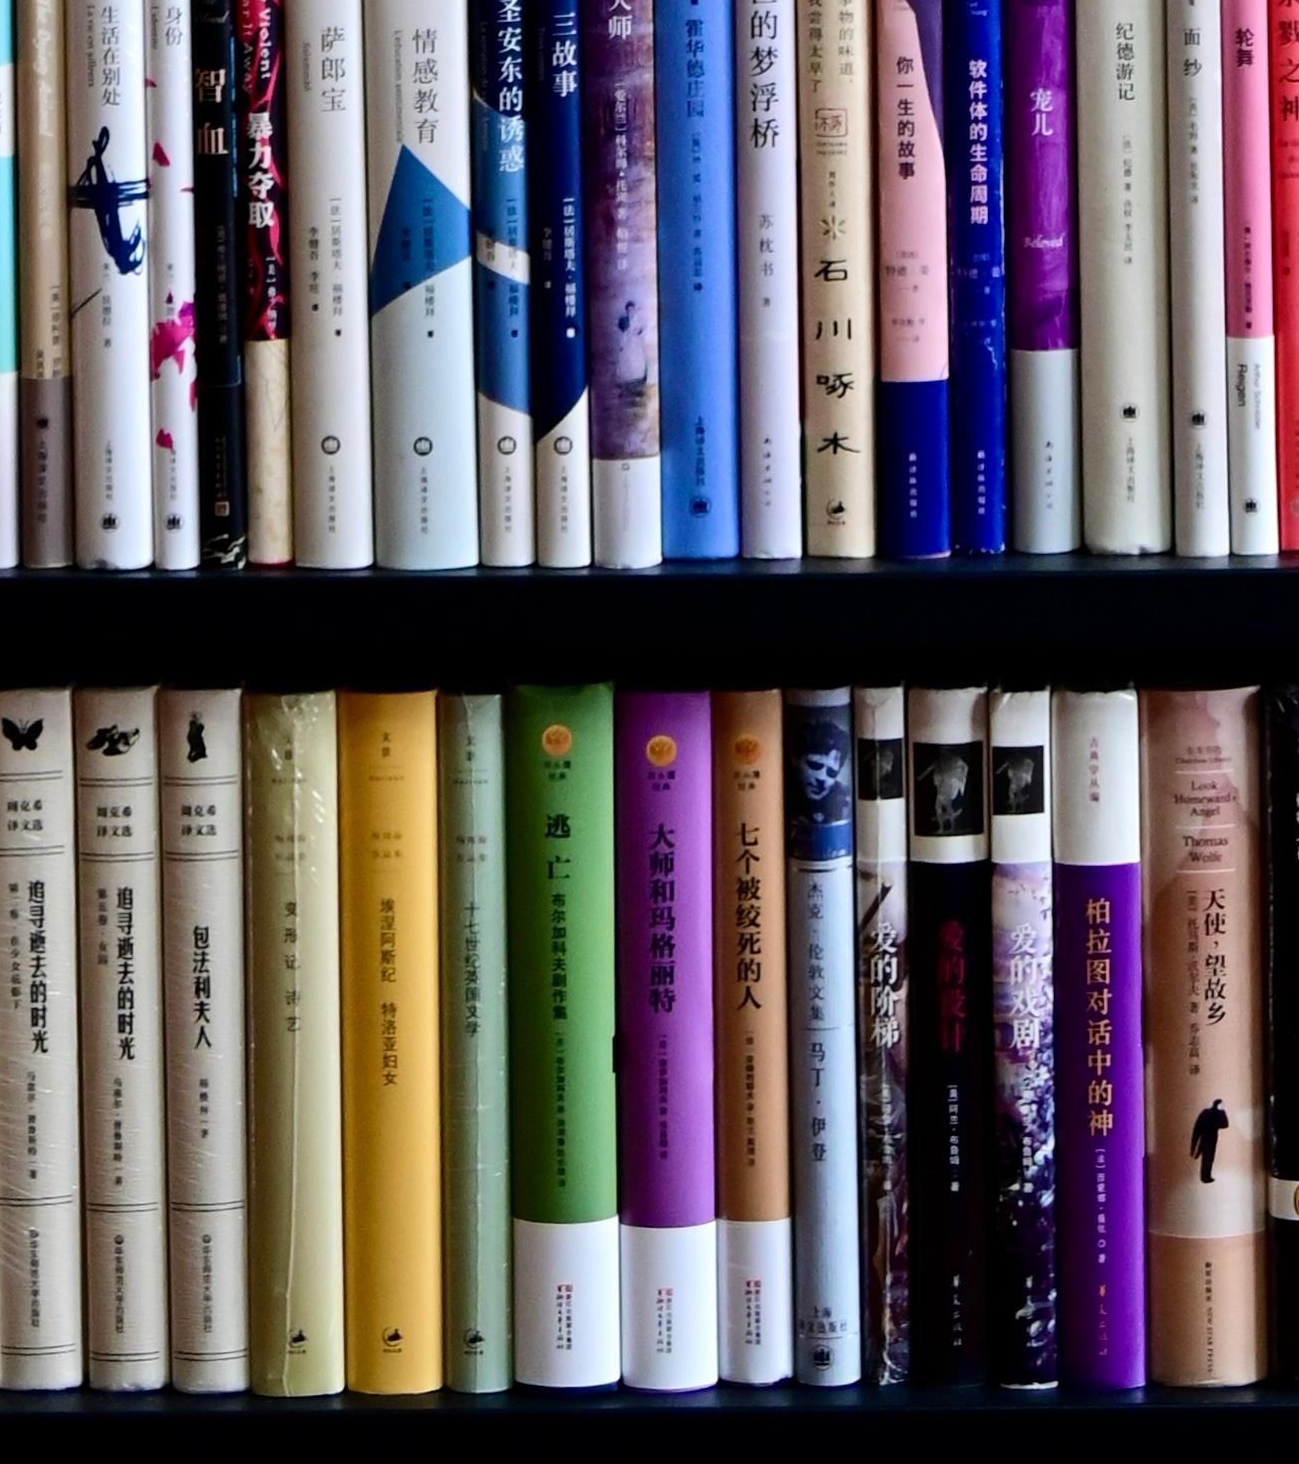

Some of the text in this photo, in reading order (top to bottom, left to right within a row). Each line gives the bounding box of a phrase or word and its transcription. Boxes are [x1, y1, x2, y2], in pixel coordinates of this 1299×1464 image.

[101, 5, 121, 107] 生活在别处
[413, 28, 439, 144] 情感教育
[552, 11, 578, 98] 三故事
[897, 55, 916, 181] 你一生的故事
[1182, 834, 1229, 848] Thomas
[28, 879, 48, 1054] 追寻逝去的时光
[649, 822, 677, 1015] 大师和玛格丽特
[193, 925, 212, 1050] 包法利夫人
[1086, 897, 1113, 1137] 柏拉图对话中的神
